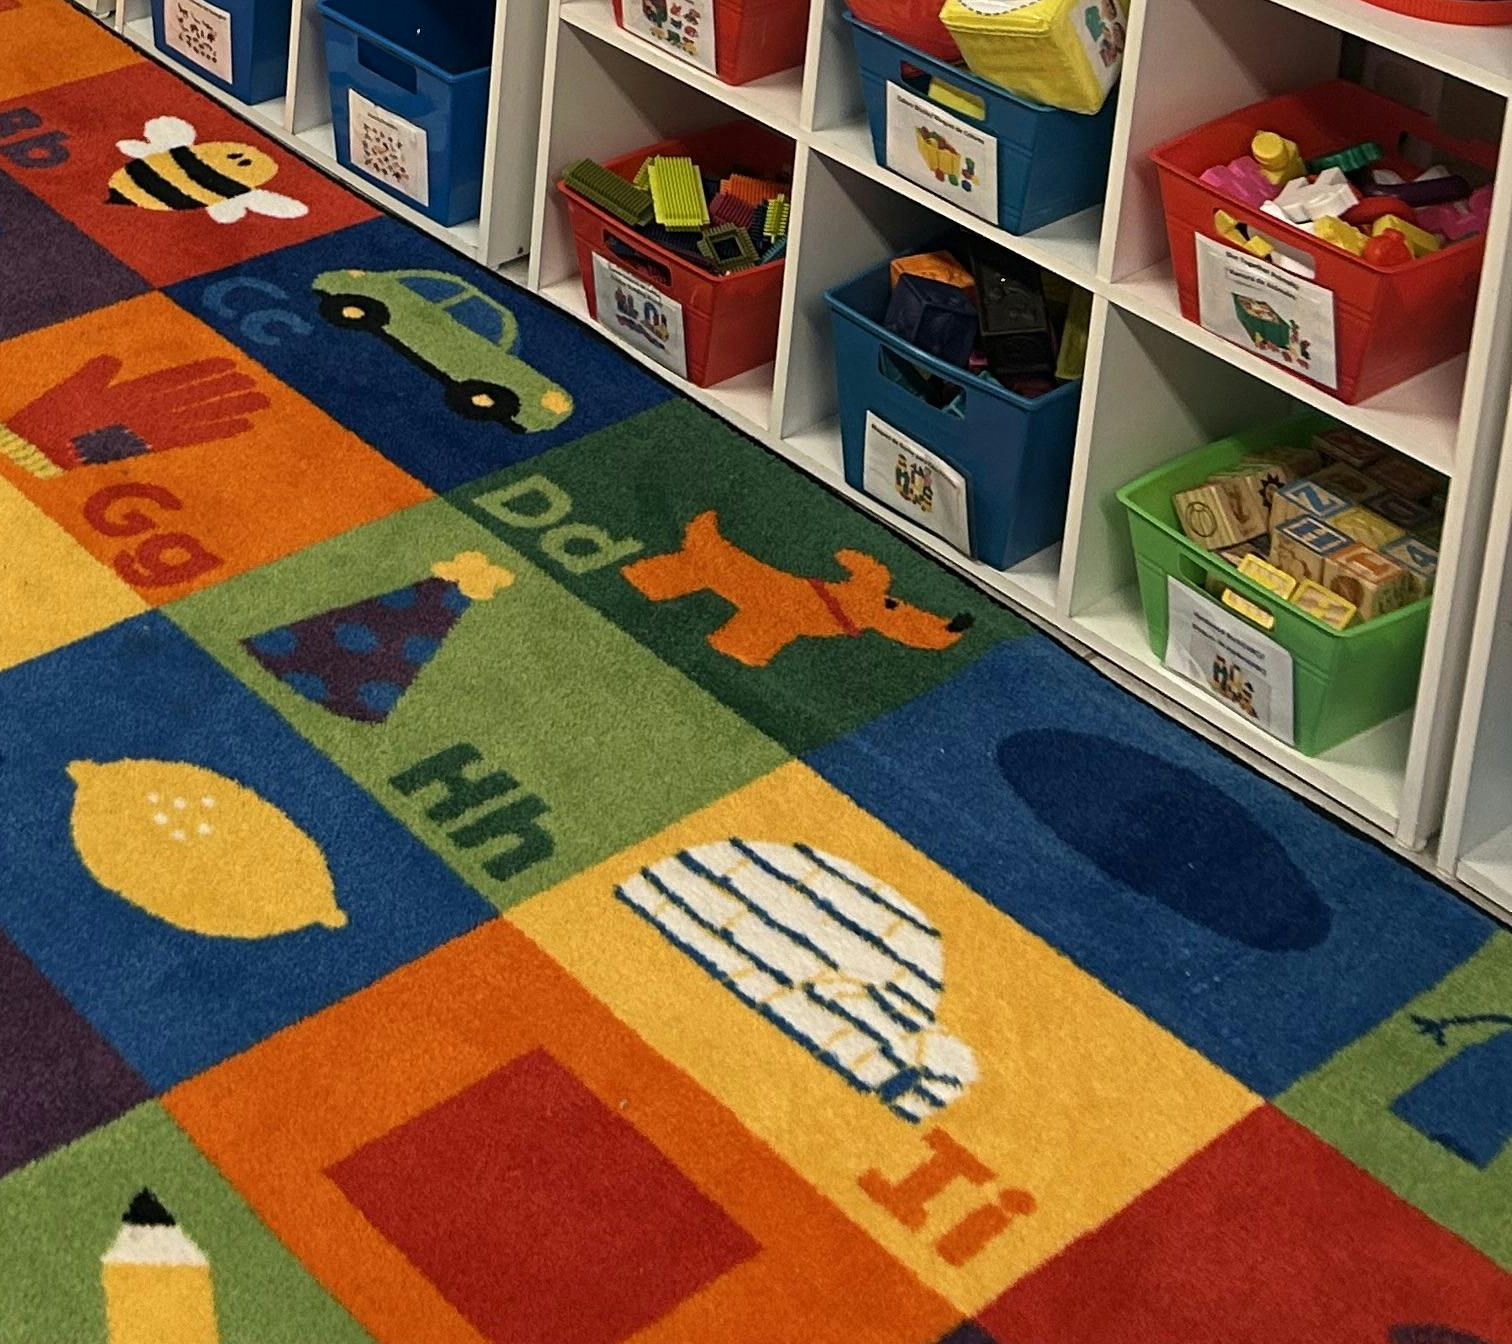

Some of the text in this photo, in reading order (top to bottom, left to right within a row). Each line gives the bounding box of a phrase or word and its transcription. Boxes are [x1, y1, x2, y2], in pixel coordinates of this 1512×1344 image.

[201, 276, 314, 348] Cc
[81, 482, 226, 589] Gg
[470, 475, 646, 576] Dd
[389, 742, 556, 882] Hh
[857, 1127, 1039, 1270] Ii
